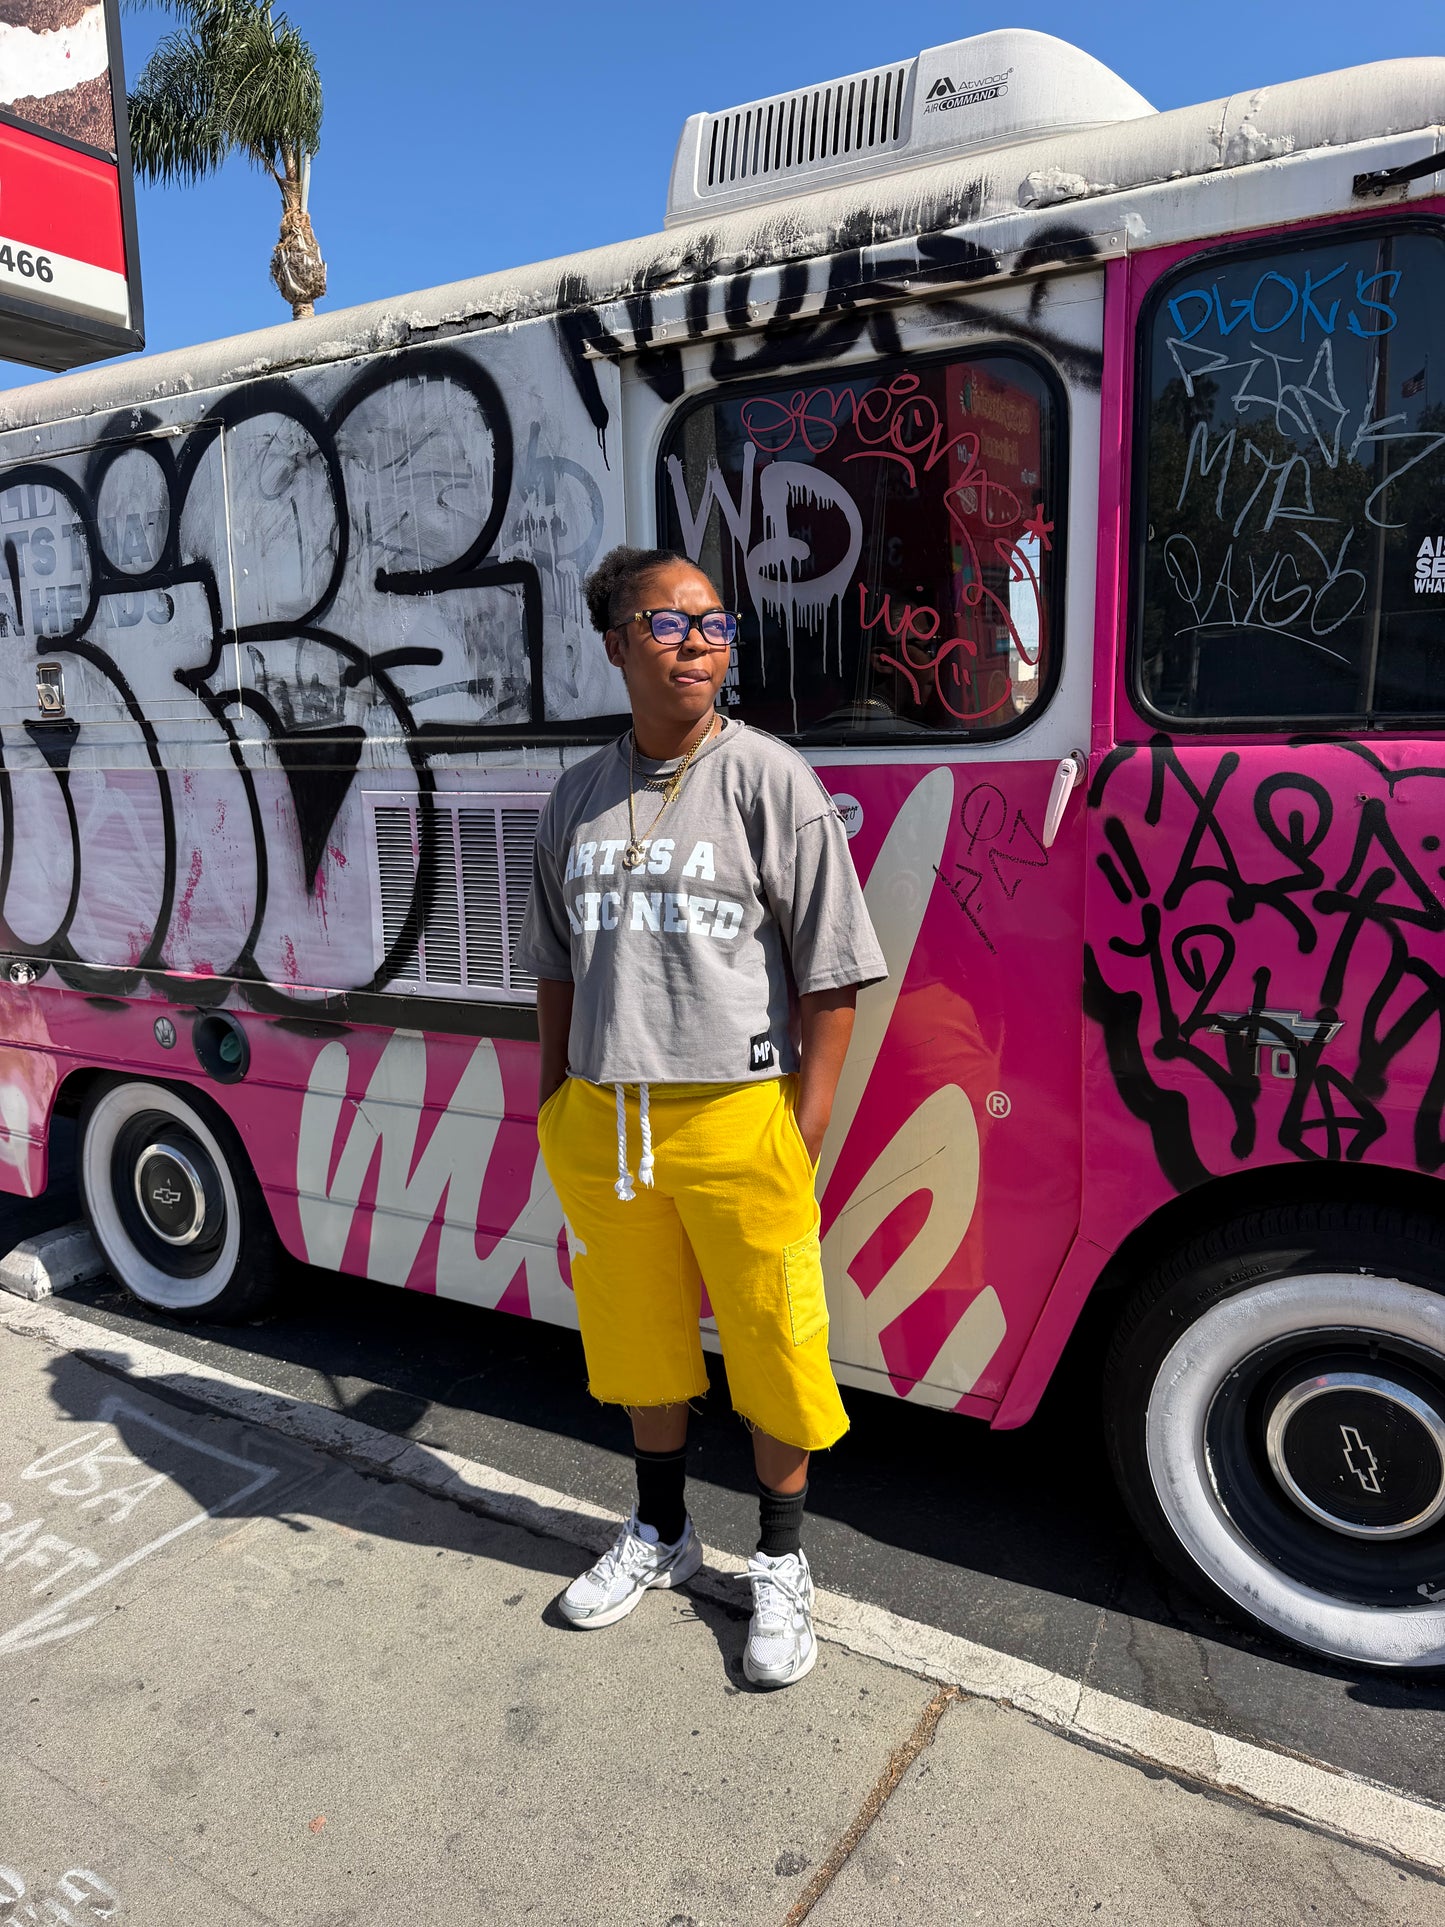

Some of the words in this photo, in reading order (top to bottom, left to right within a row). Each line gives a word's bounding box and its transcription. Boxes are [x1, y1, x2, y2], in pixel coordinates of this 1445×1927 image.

[939, 87, 998, 112] COMMAND
[1416, 535, 1445, 558] AI
[564, 839, 627, 885] ART
[631, 838, 676, 875] IS
[681, 840, 717, 882] A
[629, 891, 745, 940] NEED
[753, 1040, 770, 1063] MP
[20, 1431, 176, 1524] USA
